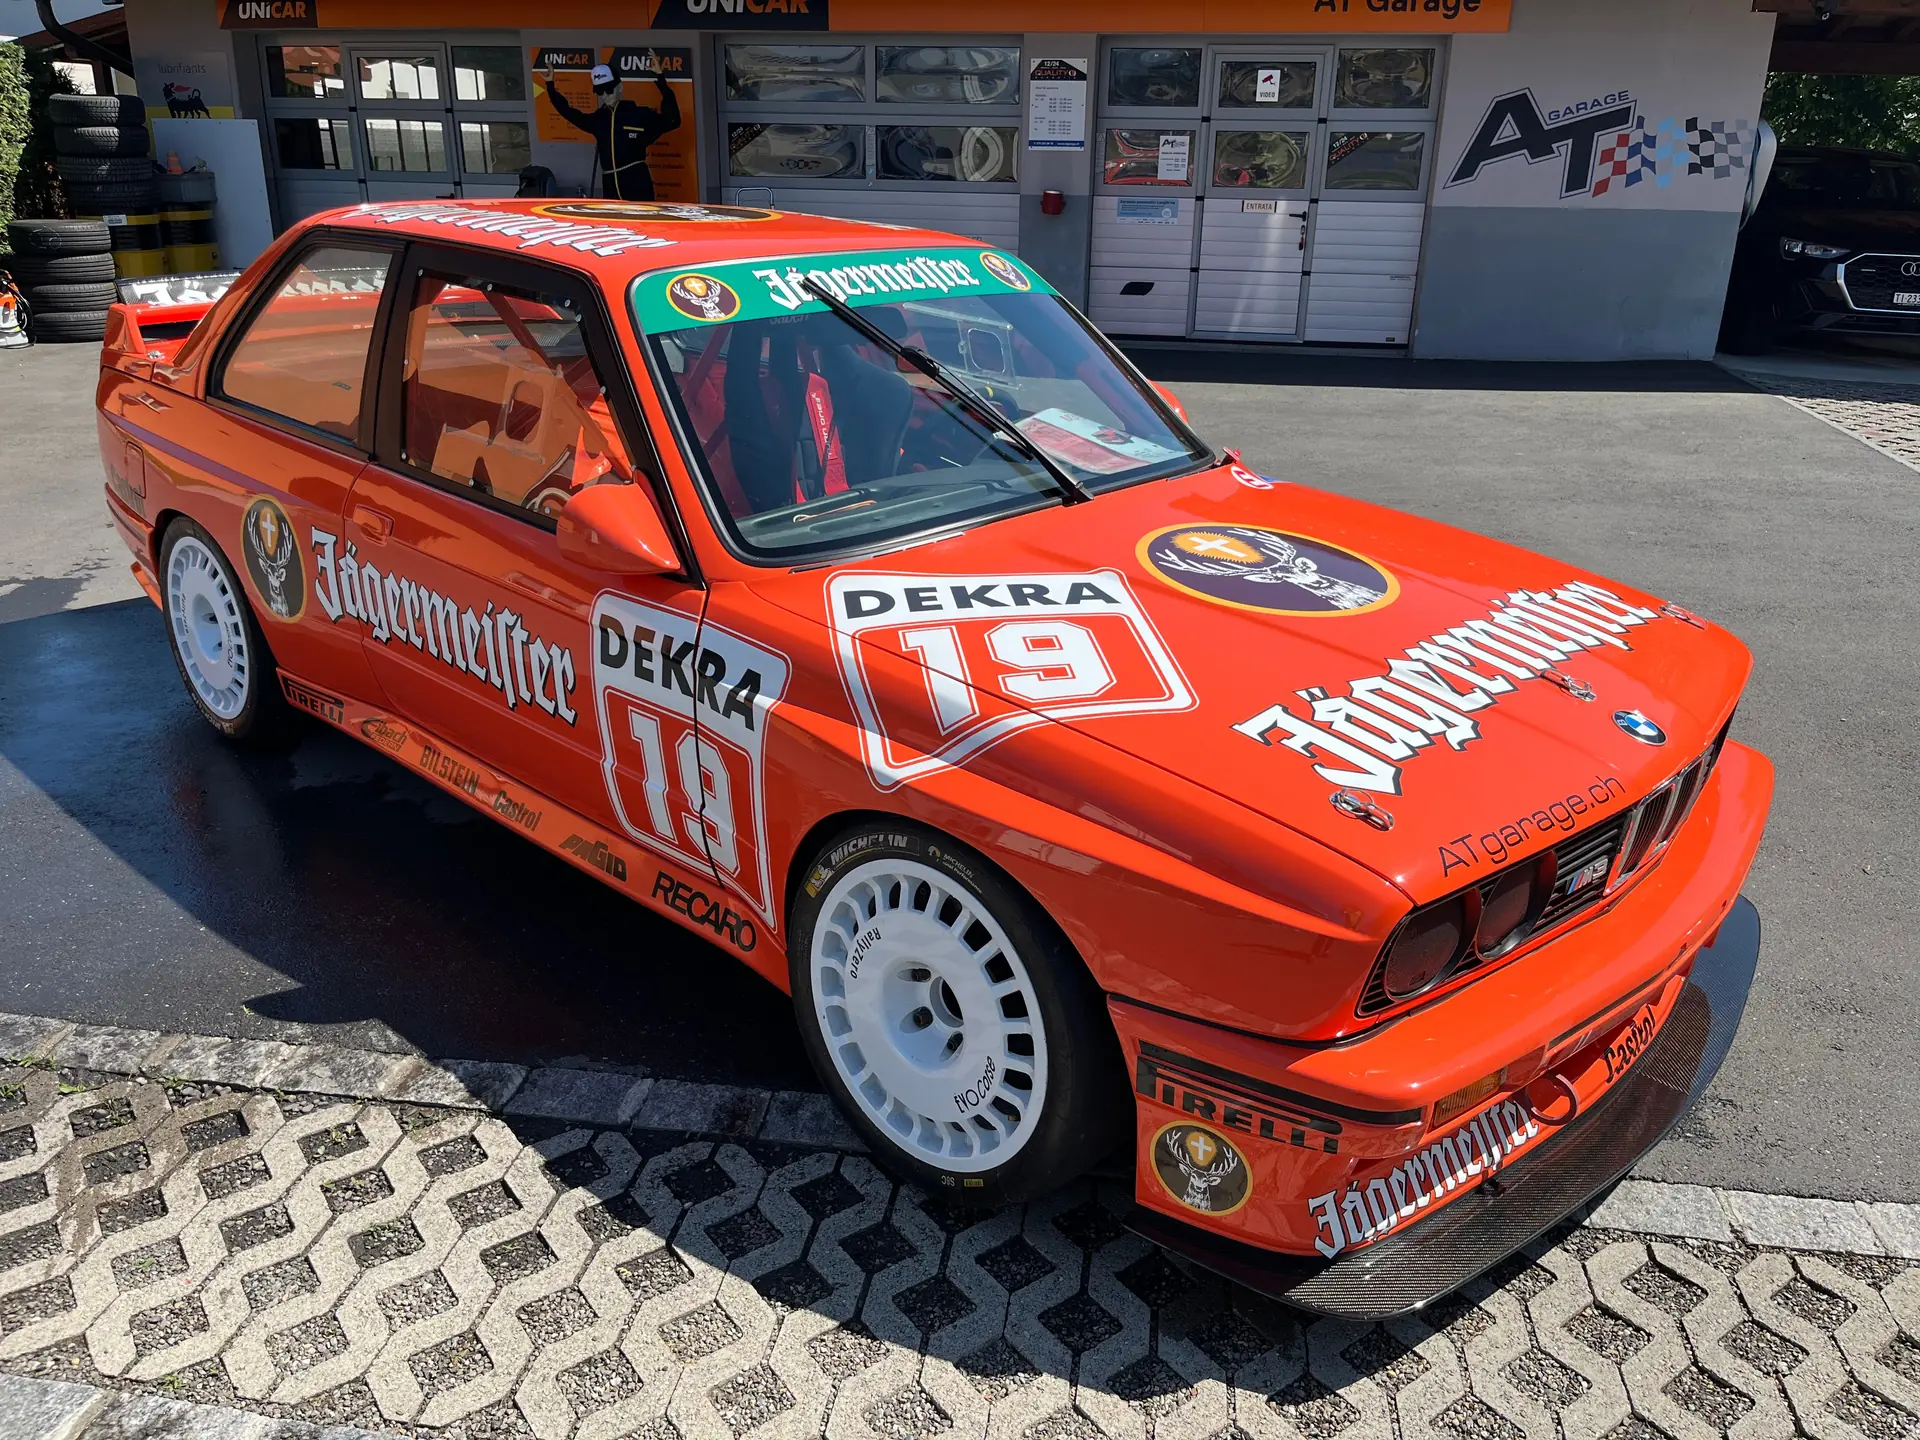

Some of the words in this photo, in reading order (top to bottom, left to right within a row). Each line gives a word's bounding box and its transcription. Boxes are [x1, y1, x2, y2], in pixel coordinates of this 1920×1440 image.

[1547, 90, 1630, 120] GARAGE
[1246, 202, 1273, 211] ENTRATA
[842, 582, 1122, 619] DEKRA
[599, 612, 762, 732] DEKRA
[898, 619, 1117, 737] 19
[281, 675, 345, 725] PIRELLI
[418, 744, 481, 796] BILSTEIN
[627, 704, 741, 878] 19
[492, 790, 543, 832] Castrol
[651, 870, 757, 952] RECARO
[1136, 1052, 1344, 1155] PIRELLI
